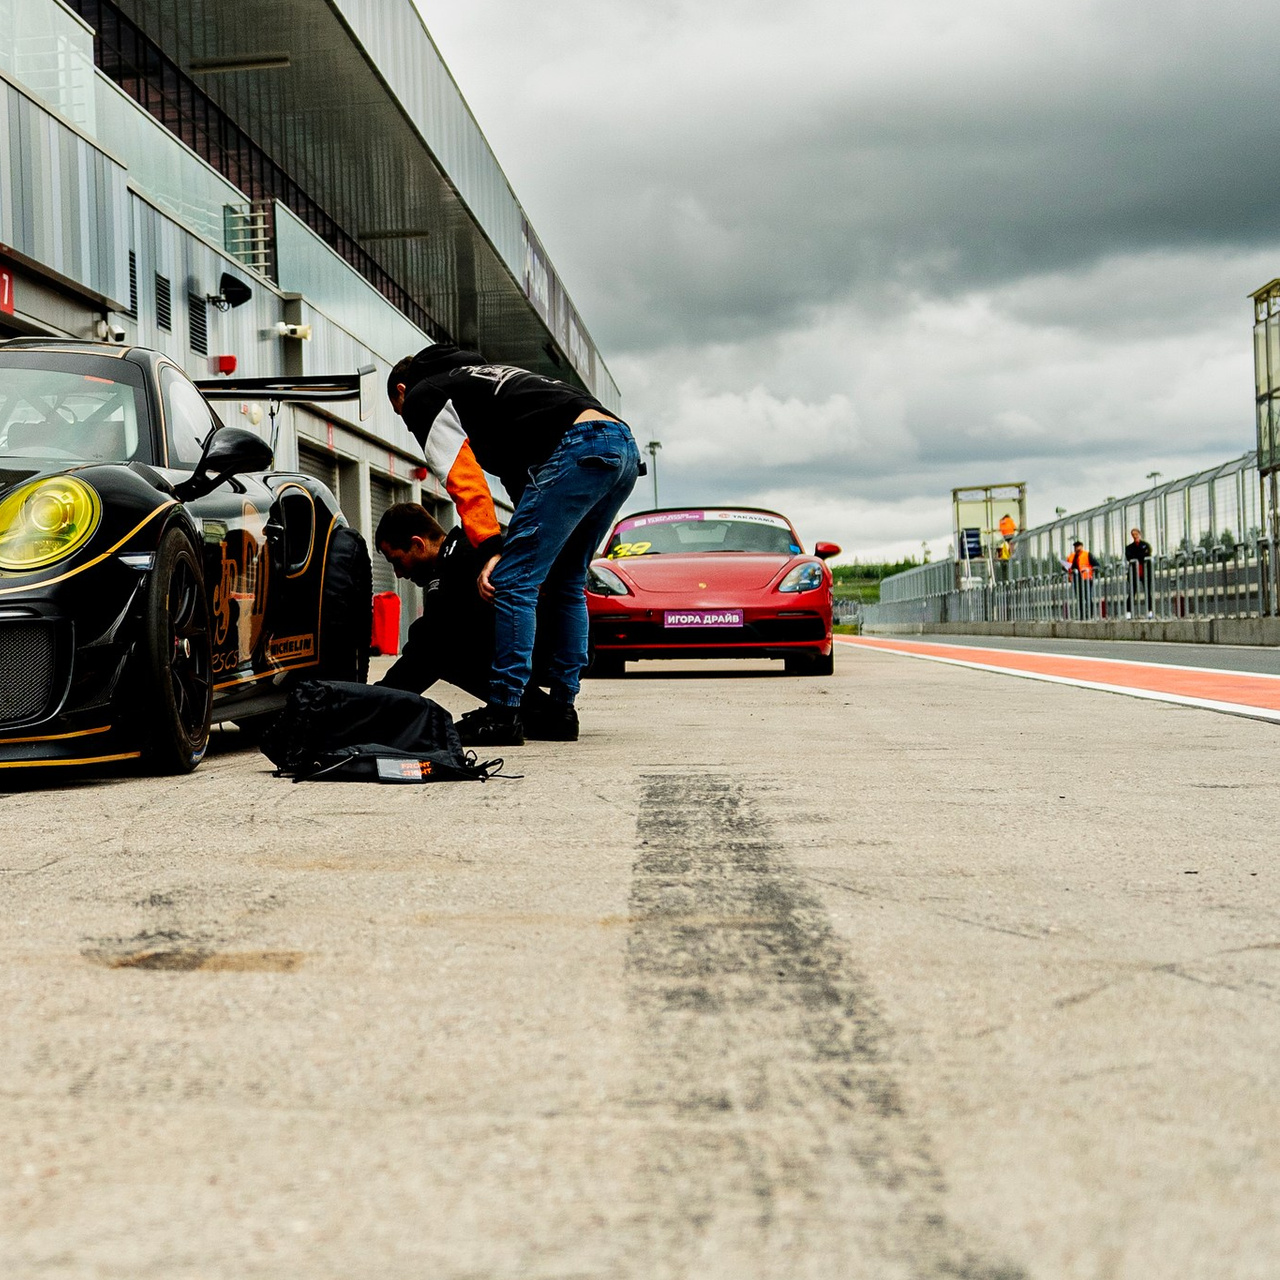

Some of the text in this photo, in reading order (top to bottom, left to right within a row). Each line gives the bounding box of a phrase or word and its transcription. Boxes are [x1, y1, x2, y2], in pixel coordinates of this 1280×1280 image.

[1, 272, 9, 305] 7
[667, 614, 740, 625] ИГОРА ДРАЙВ
